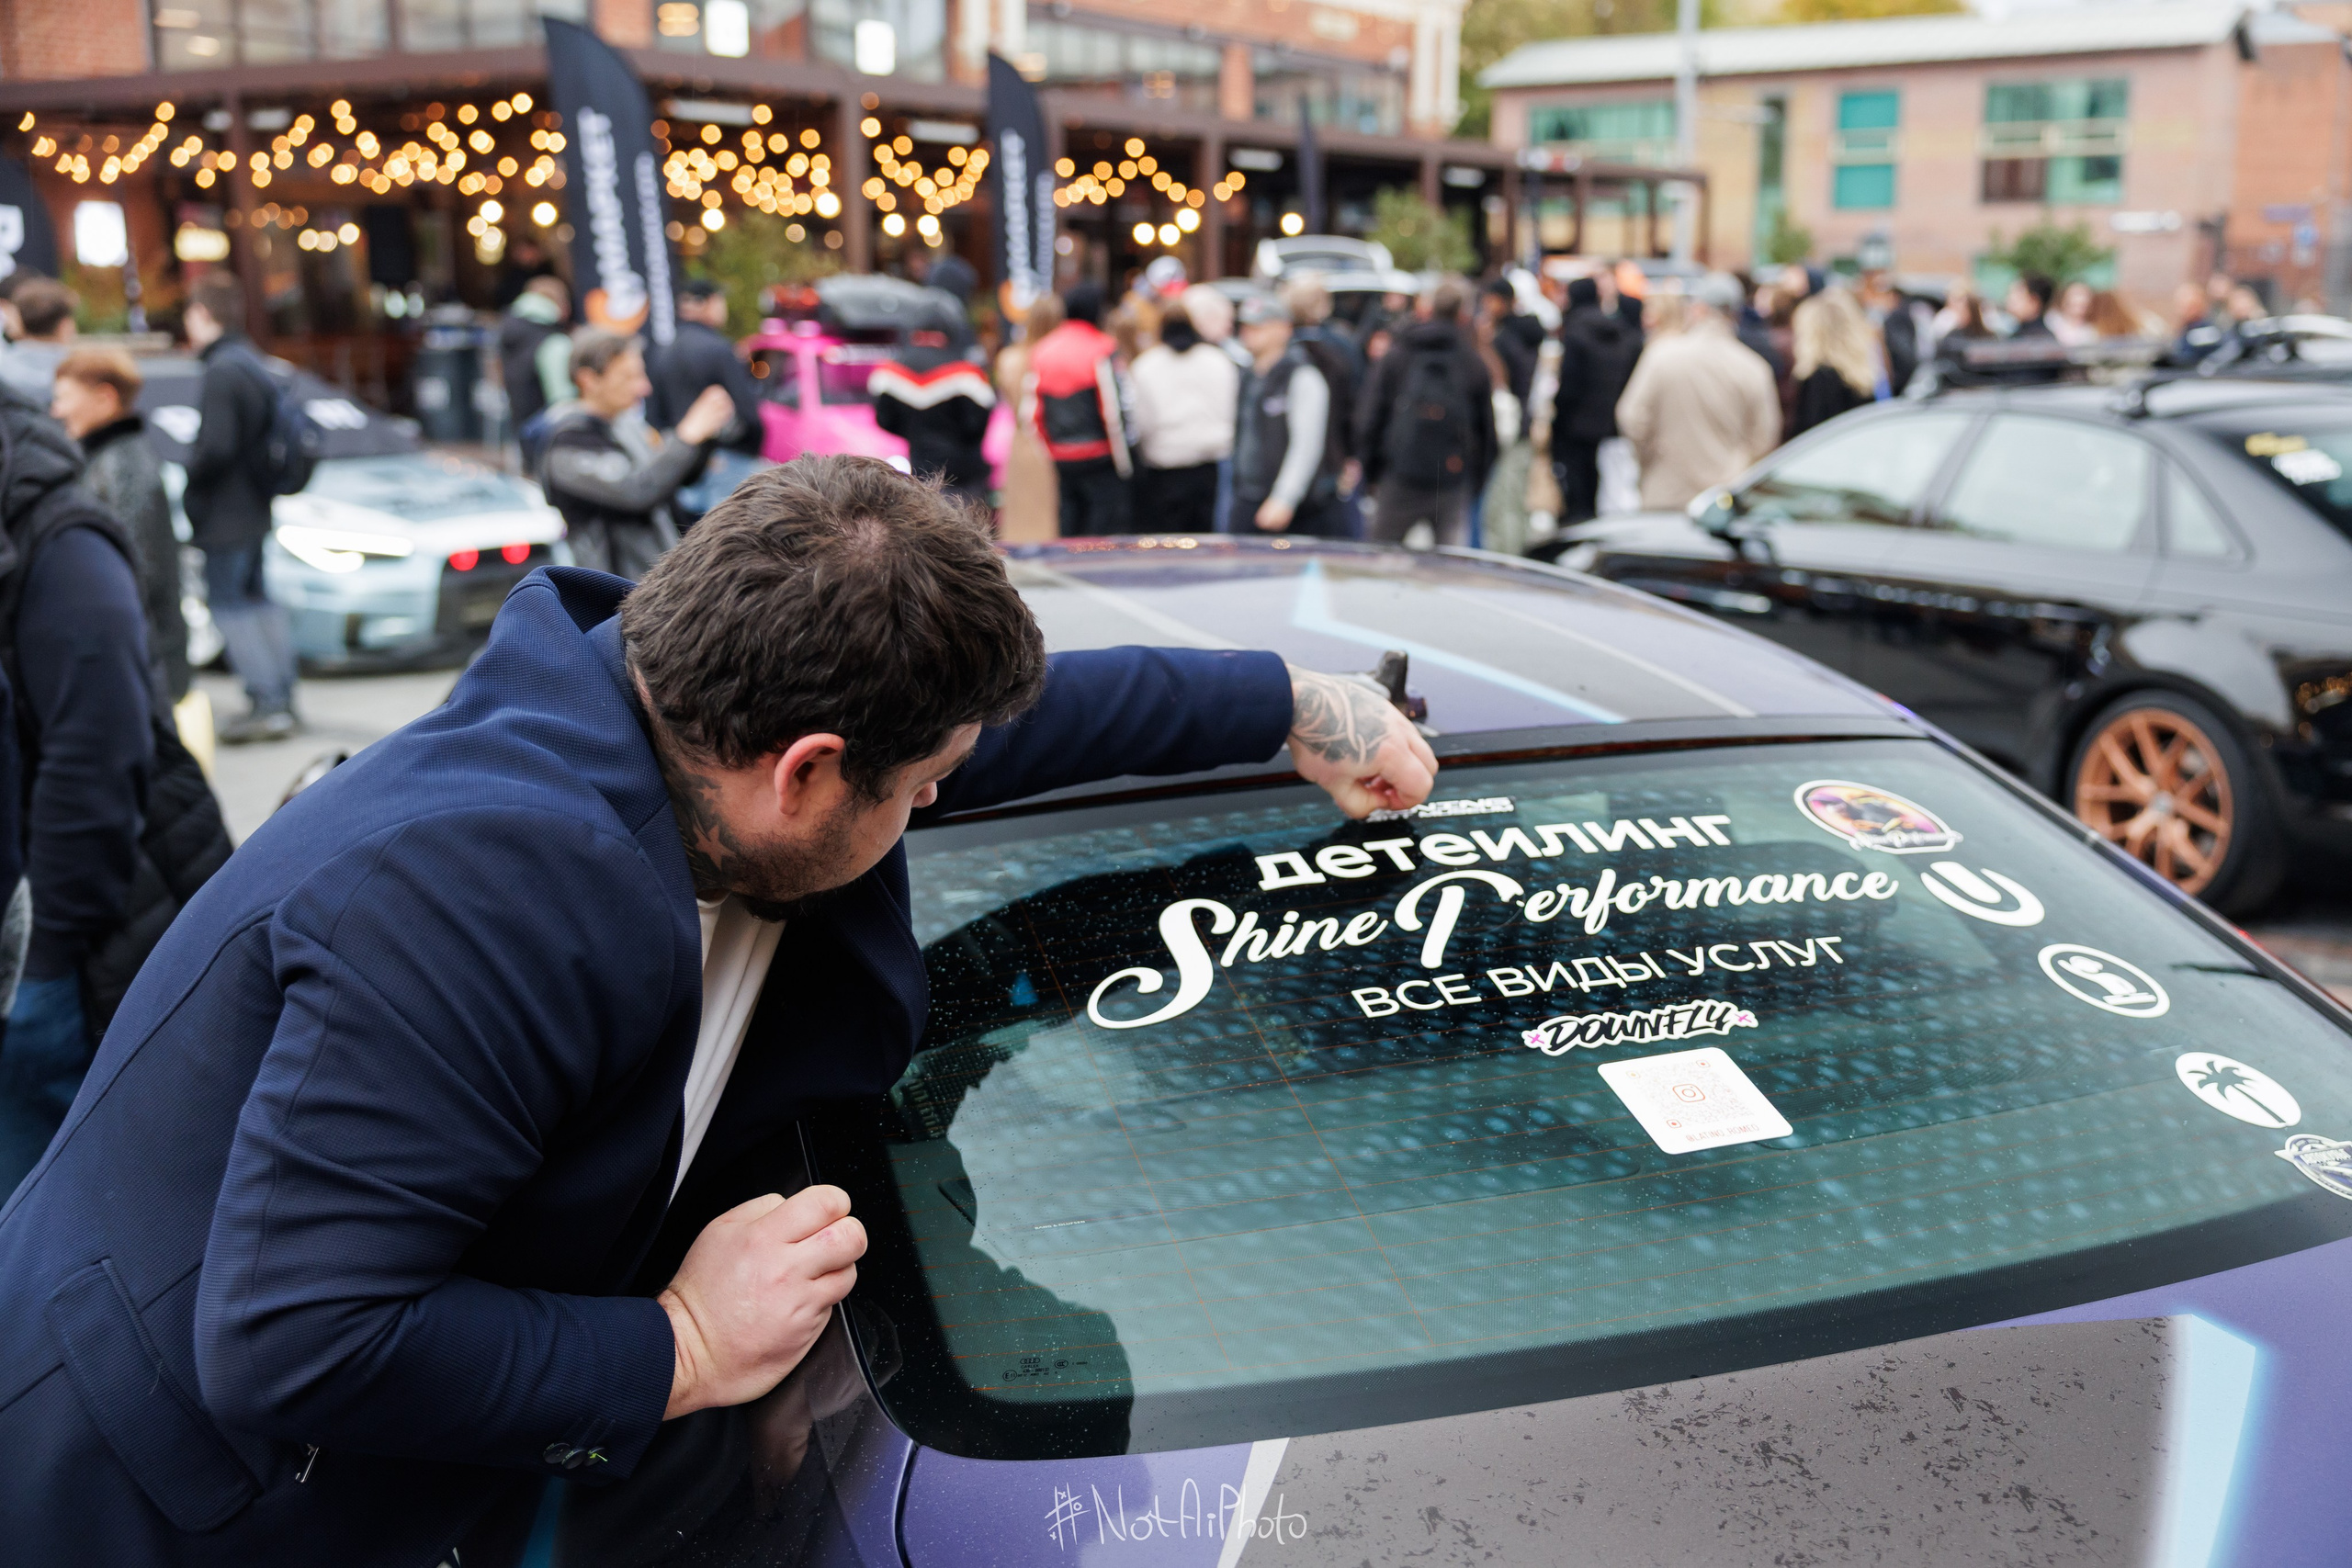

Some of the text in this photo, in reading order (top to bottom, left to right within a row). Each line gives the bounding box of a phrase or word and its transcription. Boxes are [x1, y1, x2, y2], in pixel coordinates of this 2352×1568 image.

[1087, 869, 1899, 1029] Shine Performance
[1351, 936, 1843, 1018] ВСЕ ВИДЫ УСЛУГ
